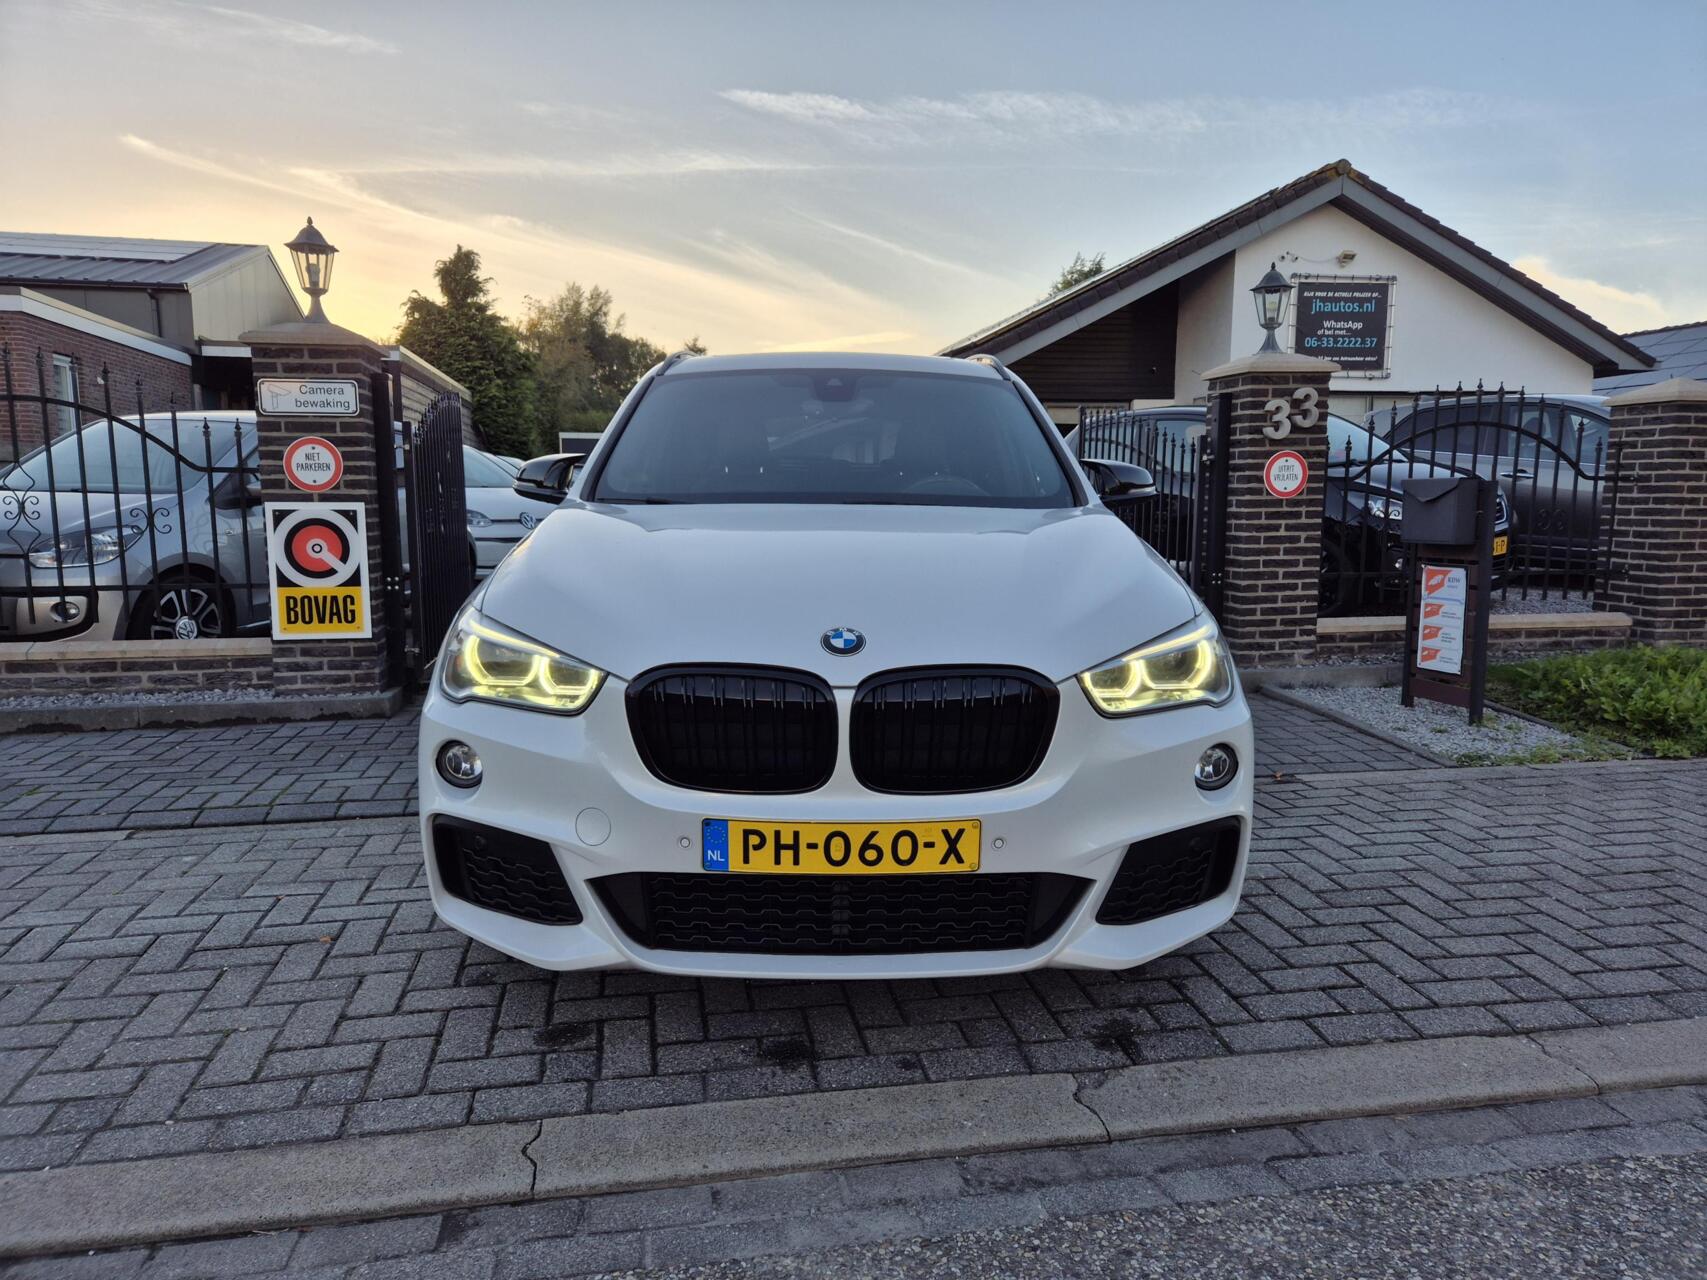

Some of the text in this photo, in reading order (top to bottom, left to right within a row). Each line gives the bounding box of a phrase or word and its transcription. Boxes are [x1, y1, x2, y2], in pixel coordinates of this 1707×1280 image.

[1311, 299, 1376, 314] jhautos.nl
[1323, 320, 1363, 330] WhatsApp
[1304, 337, 1377, 348] 06-33.2222.37
[299, 384, 345, 396] Camera
[294, 398, 351, 411] bewaking
[1262, 386, 1320, 440] 33
[304, 452, 321, 462] NIET
[296, 462, 331, 472] PARKEREN
[285, 594, 356, 625] BOVAG
[707, 828, 966, 868] NL PH-060-X
